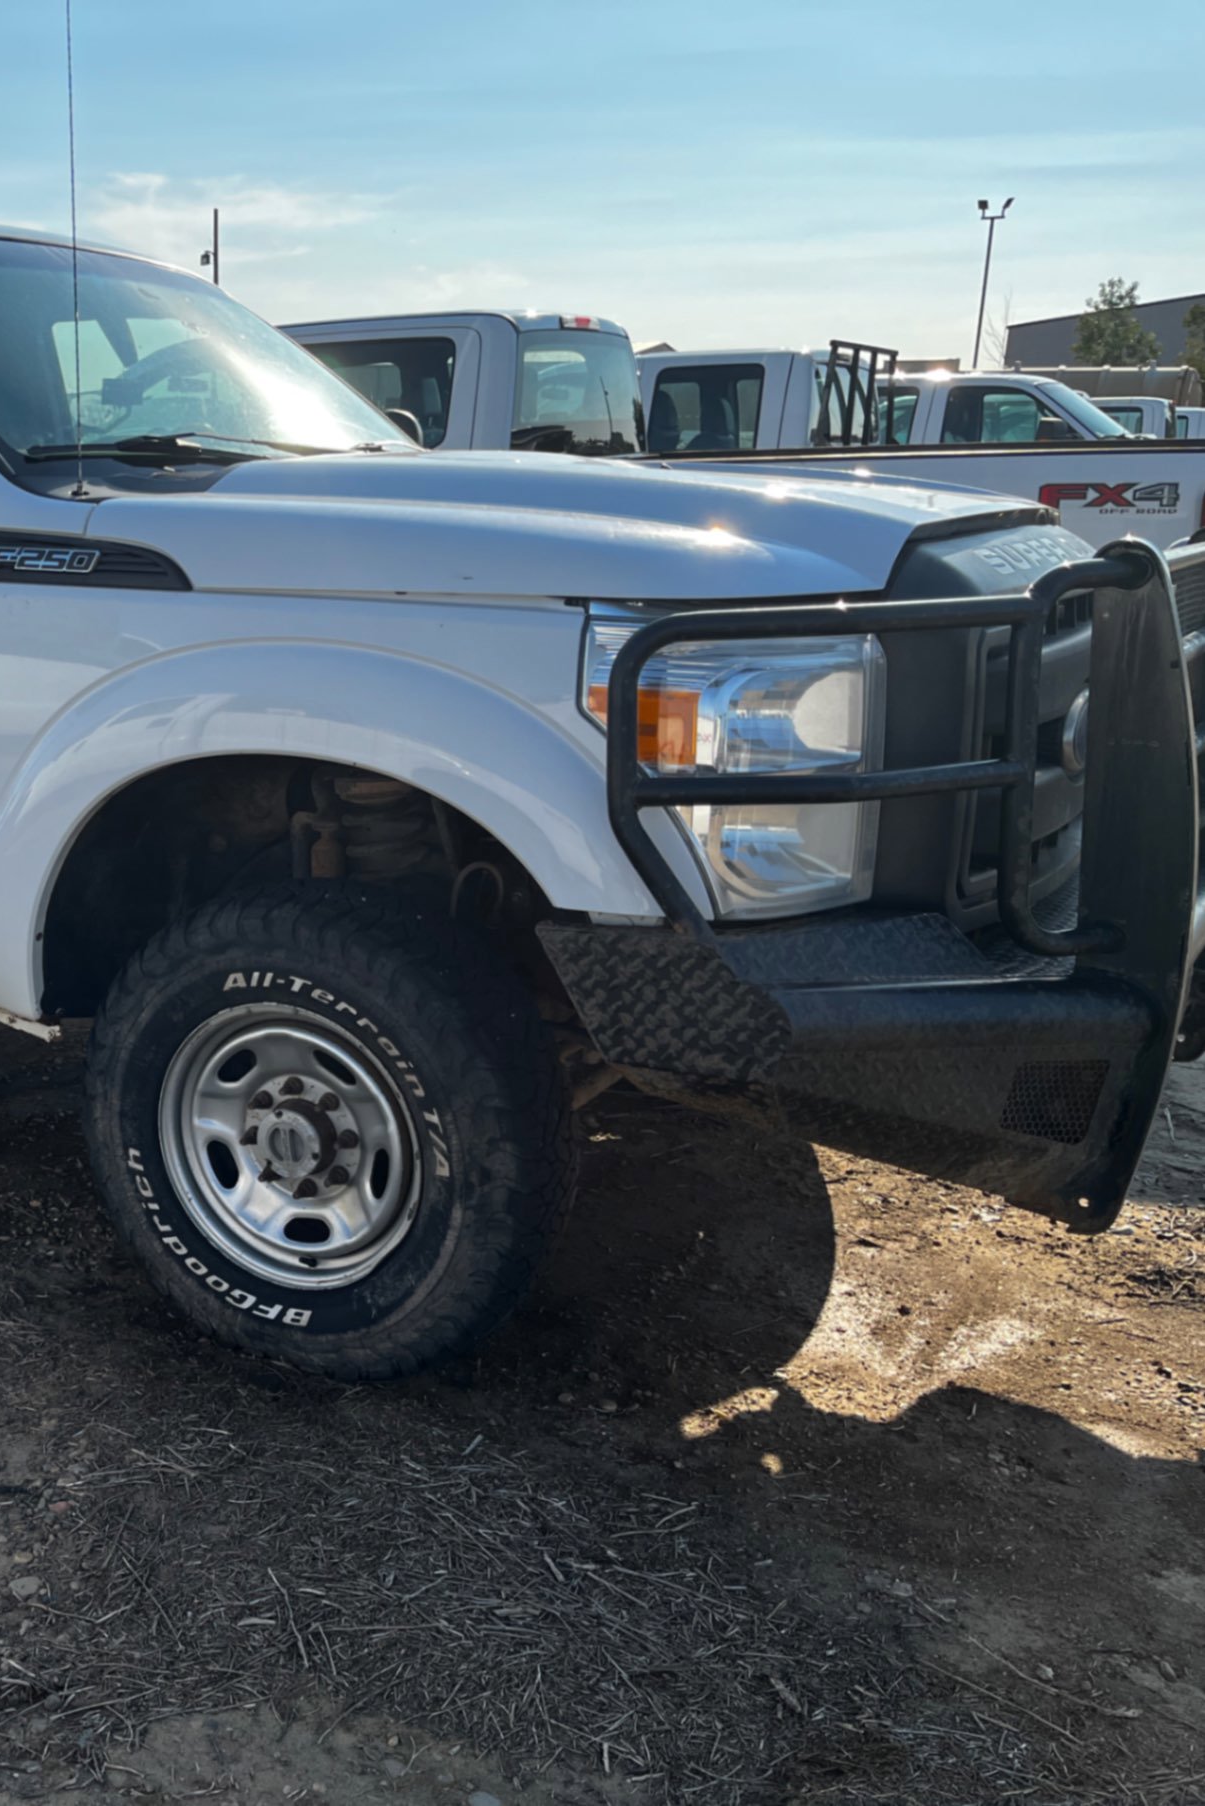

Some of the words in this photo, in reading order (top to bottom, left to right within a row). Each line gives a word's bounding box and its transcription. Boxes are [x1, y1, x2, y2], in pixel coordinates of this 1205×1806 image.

[1038, 483, 1179, 509] FX4
[223, 971, 425, 1098] All-Terrain
[423, 1107, 450, 1178] T/A
[128, 1147, 313, 1327] BFGoodrich
